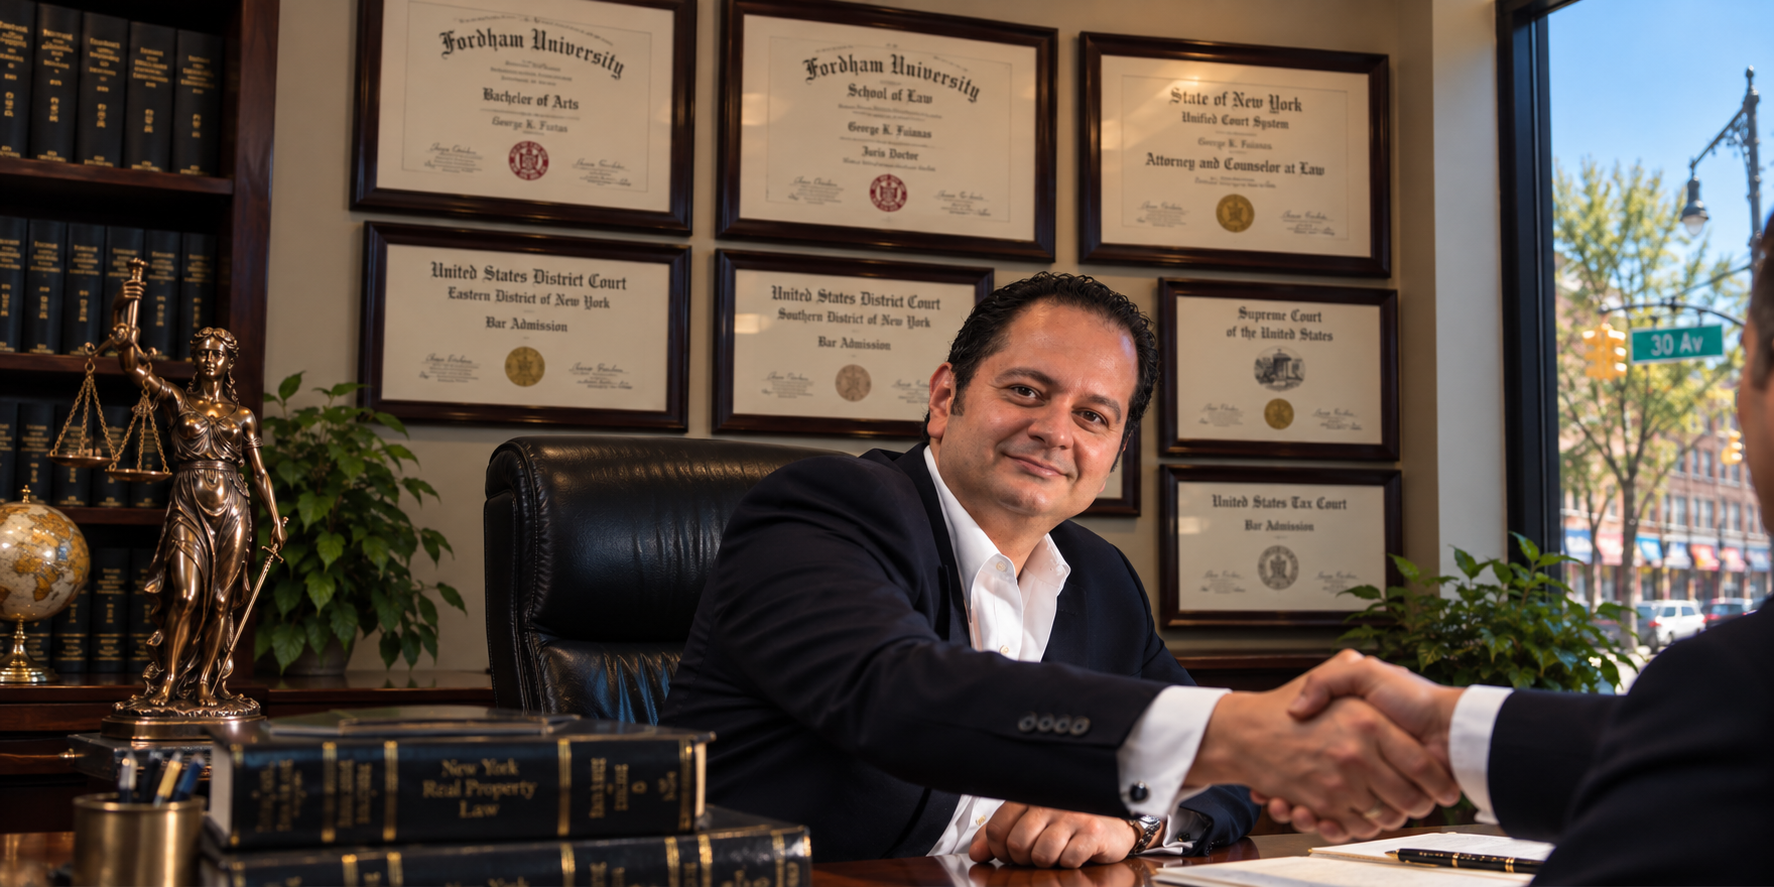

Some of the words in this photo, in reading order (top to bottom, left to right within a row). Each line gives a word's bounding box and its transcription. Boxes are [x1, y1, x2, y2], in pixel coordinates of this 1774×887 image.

[440, 28, 524, 59] Fordham
[531, 29, 625, 80] University
[803, 54, 884, 84] Fordham
[890, 54, 980, 103] University
[537, 94, 550, 107] of
[553, 95, 579, 110] Arts
[847, 83, 888, 101] School
[891, 89, 903, 101] of
[907, 89, 933, 104] Law
[1170, 87, 1209, 105] State
[1214, 92, 1228, 106] of
[1232, 92, 1263, 110] New
[1268, 94, 1303, 114] York
[1182, 111, 1217, 125] Unified
[1221, 114, 1249, 127] Court
[1253, 116, 1289, 130] System
[1145, 152, 1195, 171] Attorney
[1199, 157, 1220, 170] and
[1224, 157, 1281, 174] Counselor
[1284, 164, 1296, 175] at
[1299, 162, 1325, 176] Law
[431, 261, 477, 280] United
[483, 265, 527, 283] States
[533, 268, 583, 287] District
[588, 273, 627, 290] Court
[447, 286, 491, 300] Eastern
[495, 289, 536, 304] District
[540, 292, 551, 305] of
[554, 293, 580, 308] New
[584, 295, 610, 310] York
[771, 285, 812, 302] United
[816, 289, 856, 305] States
[860, 291, 904, 309] District
[908, 294, 941, 310] Court
[485, 316, 507, 329] Bar
[510, 317, 568, 333] Admission
[777, 307, 823, 323] Southern
[827, 311, 864, 325] District
[867, 314, 877, 326] of
[881, 314, 903, 328] New
[906, 316, 931, 329] York
[1238, 306, 1286, 322] Supreme
[1290, 309, 1322, 323] Court
[818, 336, 837, 348] Bar
[840, 337, 891, 351] Admission
[1226, 326, 1237, 338] of
[1240, 326, 1257, 340] the
[1261, 326, 1296, 340] United
[1299, 328, 1334, 342] States
[1651, 333, 1674, 356] 30
[1679, 332, 1703, 354] Av
[1212, 494, 1248, 508] United
[1251, 495, 1287, 509] States
[1291, 496, 1313, 510] Tax
[1316, 497, 1347, 510] Court
[1245, 519, 1263, 531] Bar
[1265, 520, 1315, 532] Admission
[441, 759, 476, 778] New
[481, 758, 519, 776] York
[423, 778, 460, 798] Real
[464, 778, 537, 800] Property
[459, 801, 499, 818] Law
